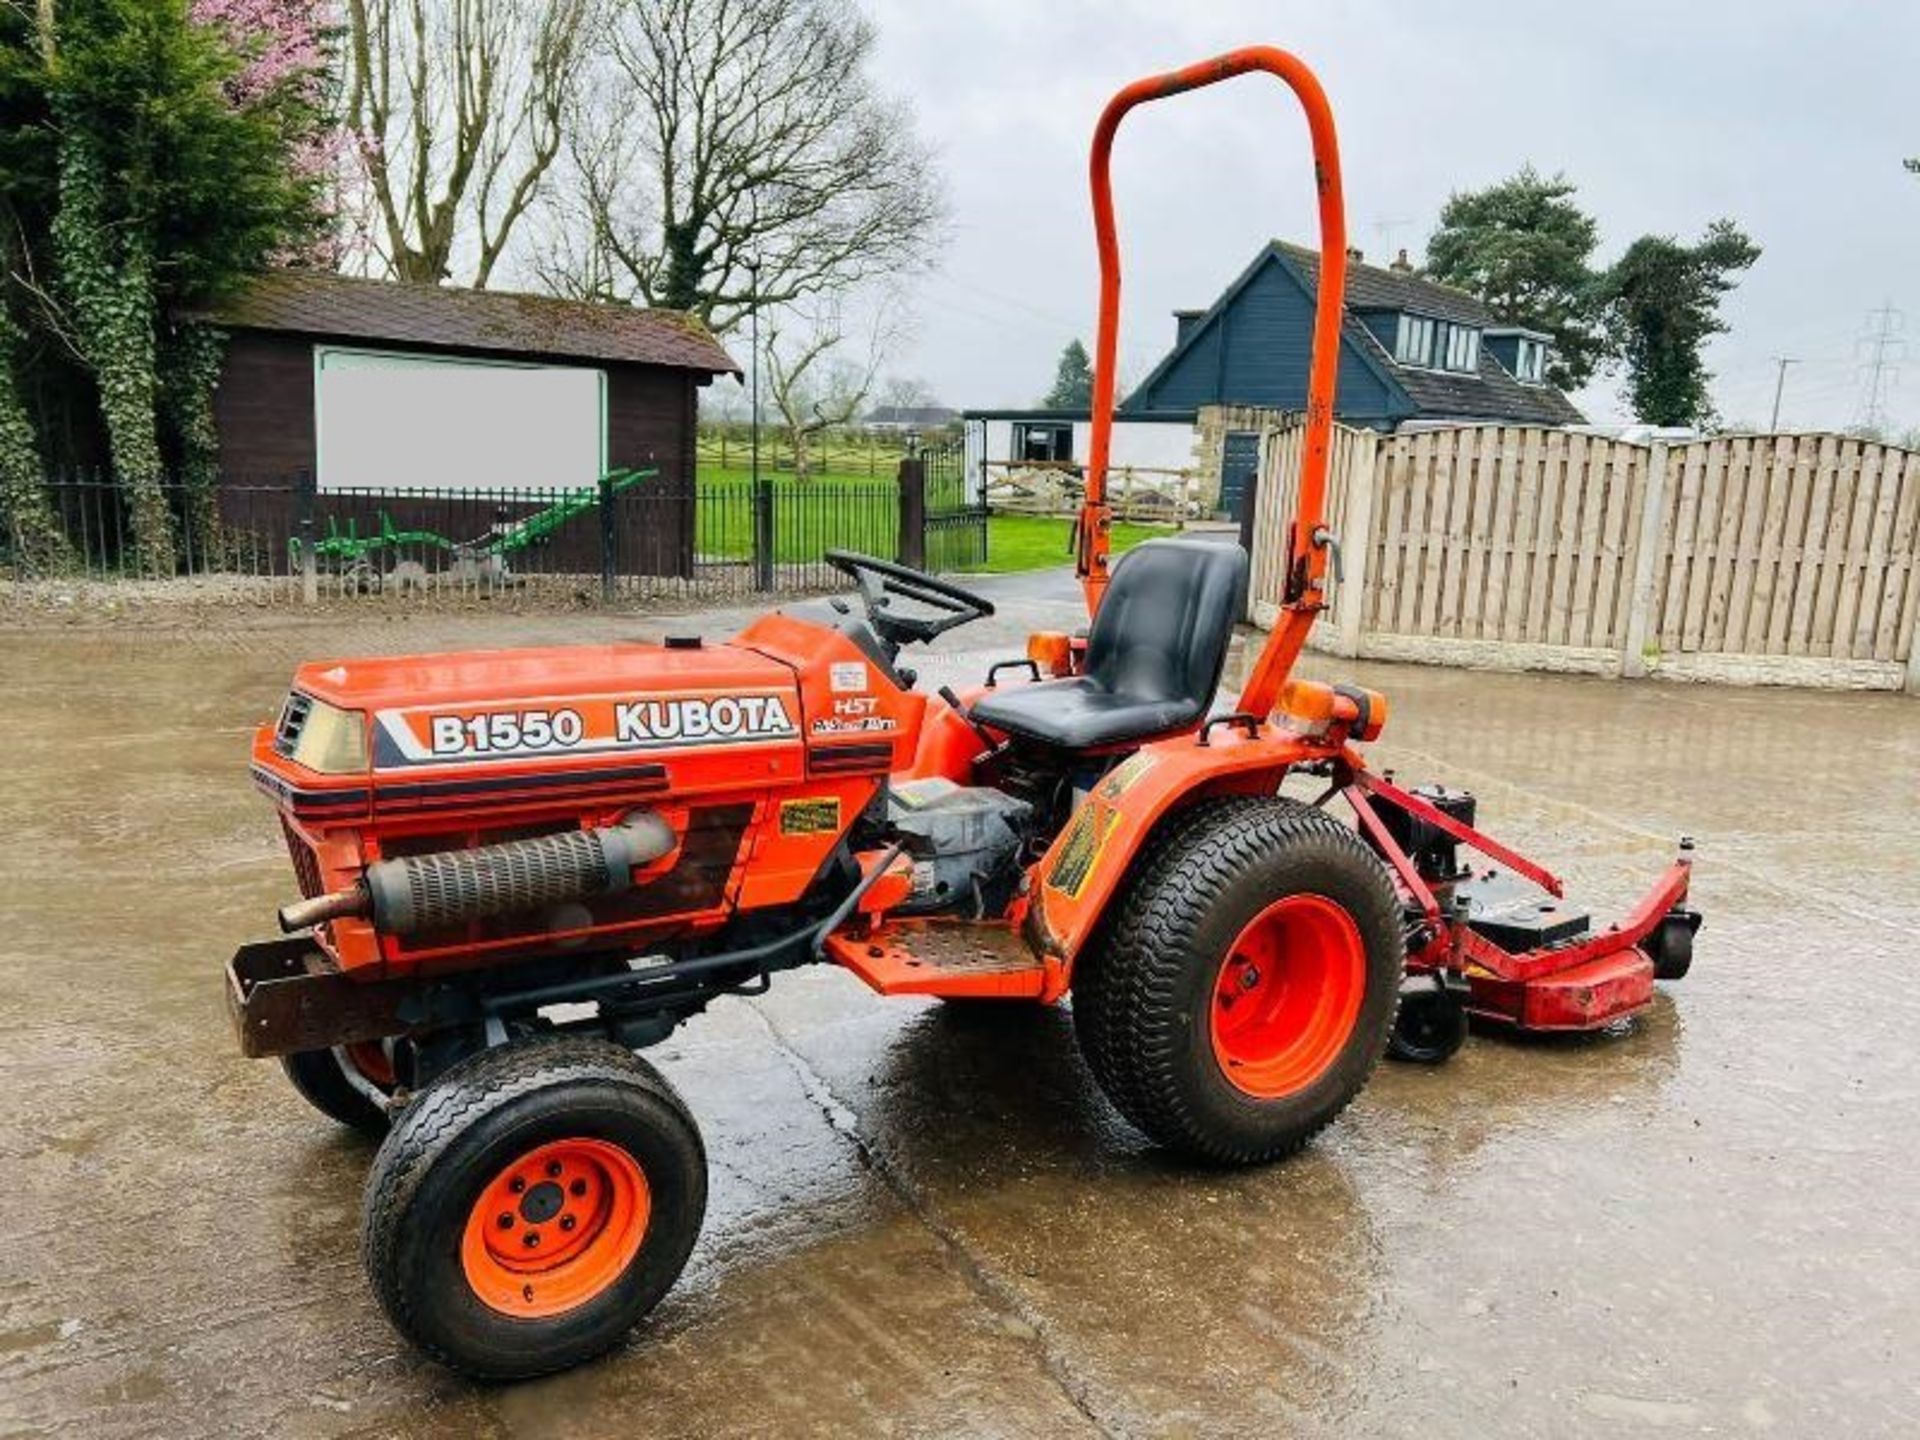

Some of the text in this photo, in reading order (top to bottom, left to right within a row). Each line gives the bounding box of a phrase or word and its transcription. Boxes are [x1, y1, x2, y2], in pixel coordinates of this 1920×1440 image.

[834, 698, 879, 714] HST
[431, 696, 792, 753] B1550 KUBOTA
